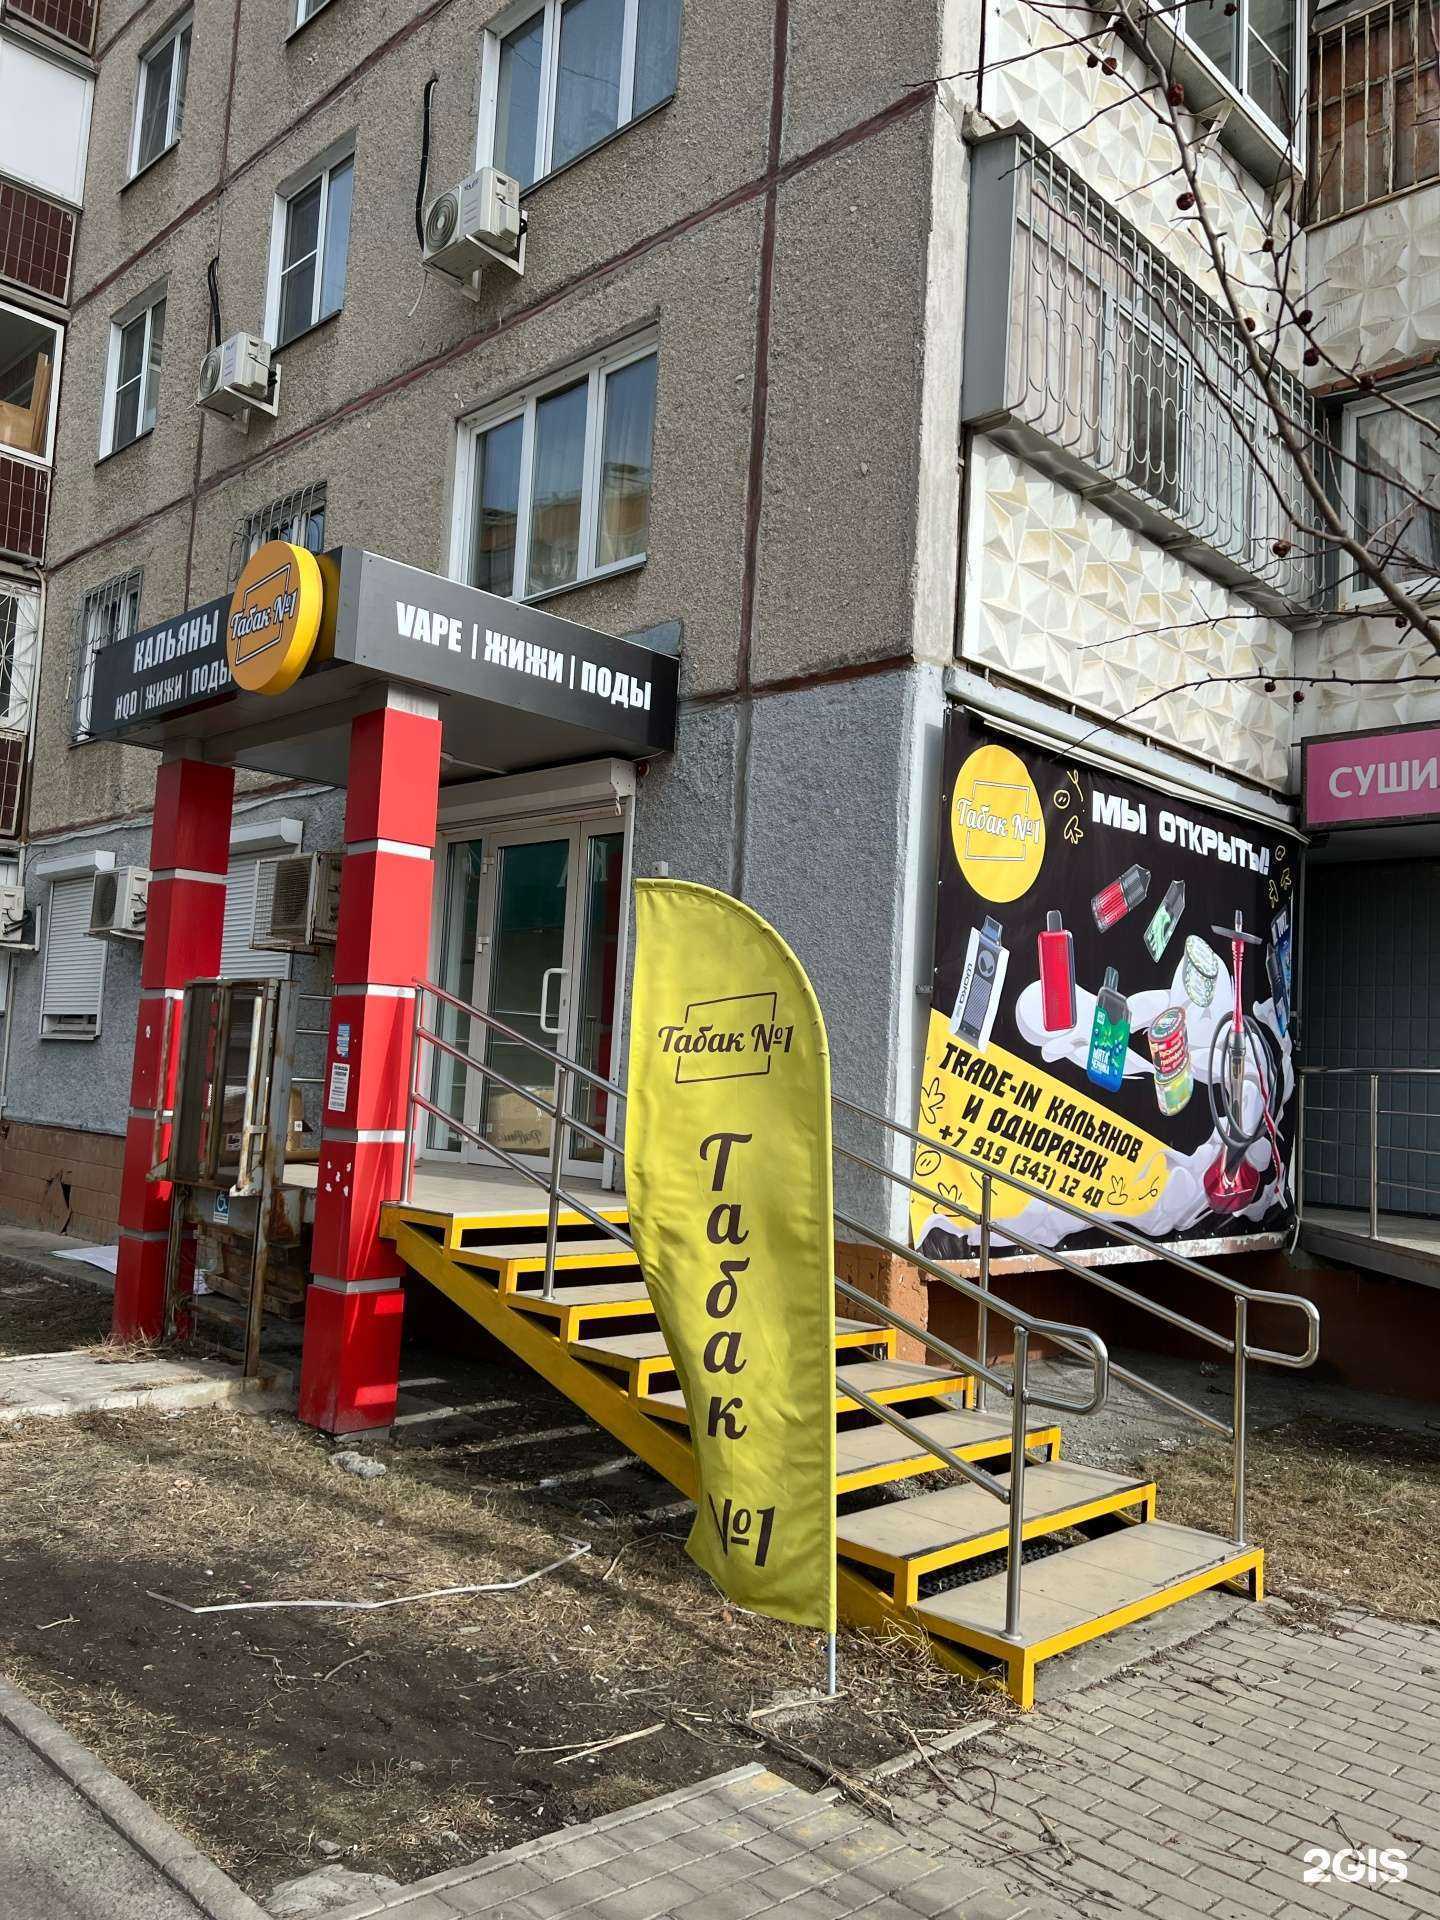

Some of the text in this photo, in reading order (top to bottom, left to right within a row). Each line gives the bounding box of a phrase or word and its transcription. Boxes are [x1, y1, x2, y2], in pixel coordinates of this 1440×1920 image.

[133, 610, 219, 673] КАЛЬЯНЫ
[230, 588, 298, 640] Табак №1
[395, 601, 652, 711] VAPE ЖИЖИ ПОДЫ
[115, 690, 138, 720] HQD
[145, 674, 183, 710] ЖИЖИ
[1328, 757, 1438, 798] СУШИ
[957, 797, 1041, 844] Табак №1
[1091, 790, 1270, 875] МЫ ОТКРЫТЫ!
[658, 1023, 795, 1053] Табак №1
[939, 1042, 1144, 1163] TRADE-IN КАЛЬЯНОВ
[961, 1094, 1109, 1181] И ОДНОРАЗОК
[938, 1125, 1105, 1208] +7 919 (343) 12 40
[699, 1132, 753, 1440] Табак
